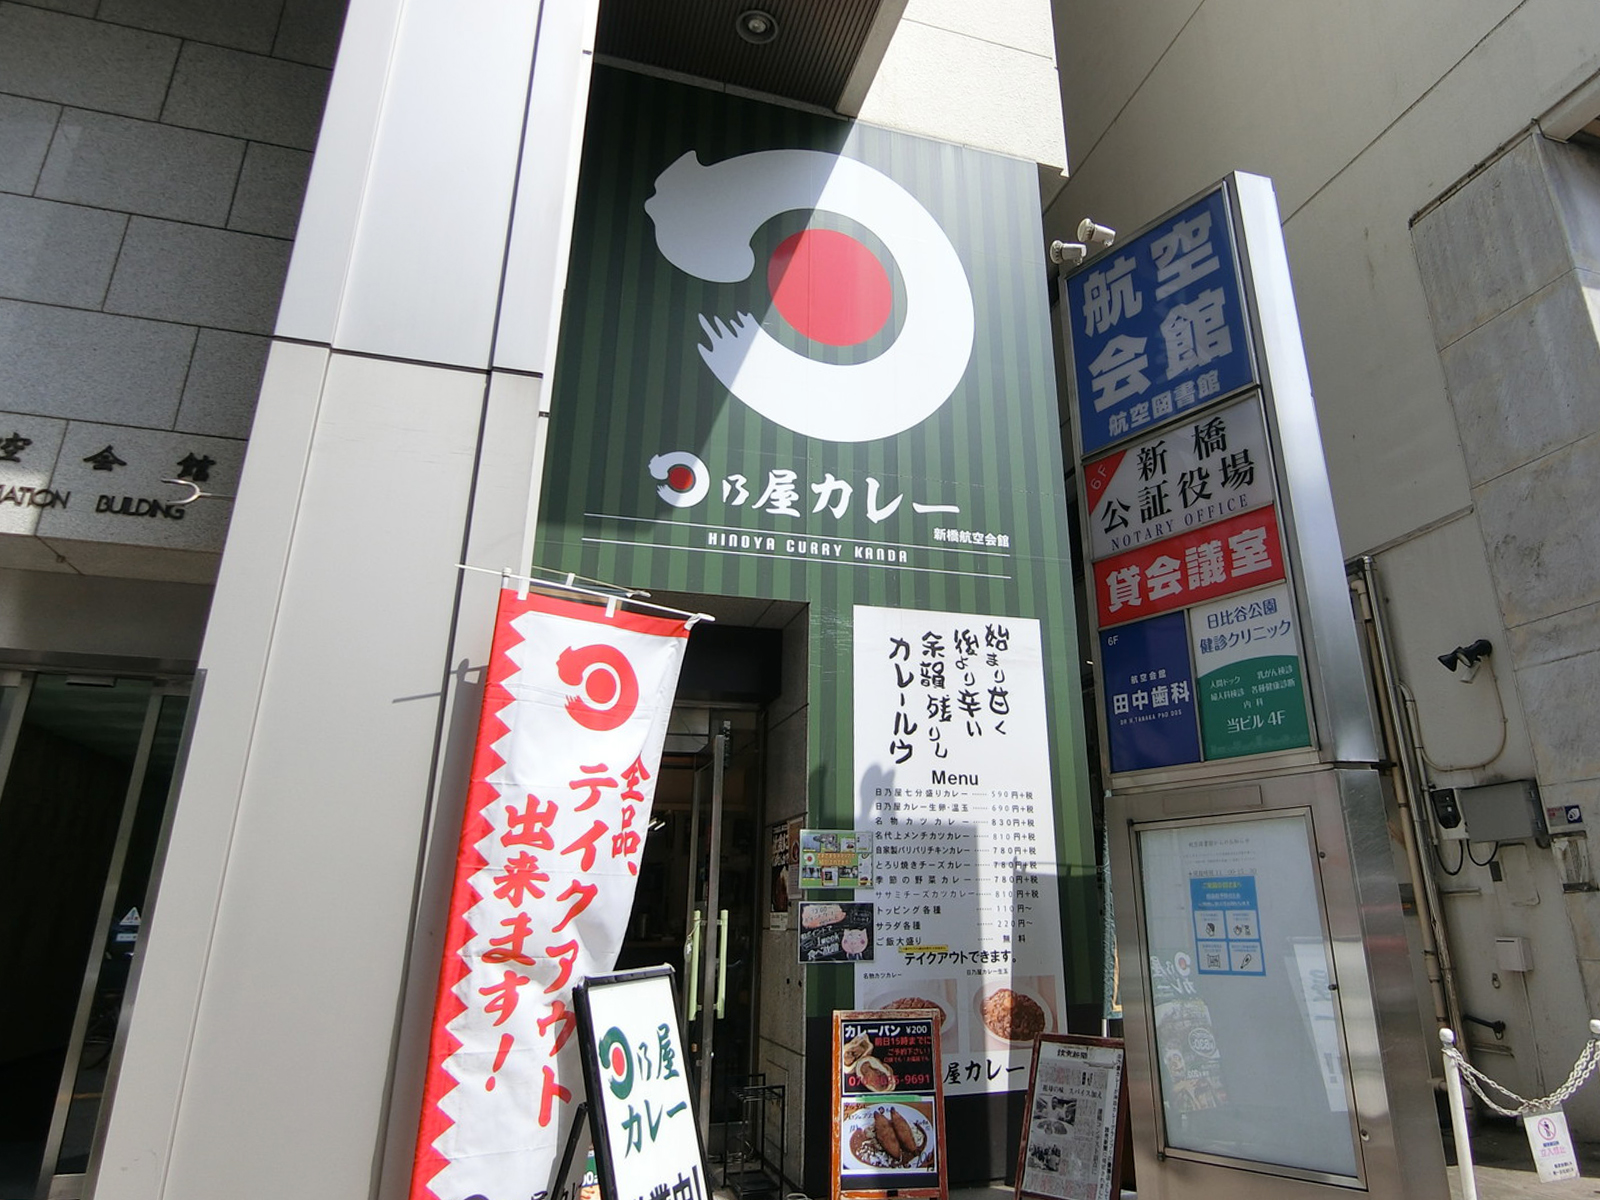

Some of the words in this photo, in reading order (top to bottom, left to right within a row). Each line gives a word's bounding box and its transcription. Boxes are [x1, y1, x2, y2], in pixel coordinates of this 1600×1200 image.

[1136, 416, 1226, 481] 新橋
[1090, 463, 1108, 490] 6F
[96, 494, 186, 520] BUILDING
[1101, 449, 1254, 535] 公証役場
[933, 526, 1010, 548] 新橋航空会館
[1111, 519, 1175, 551] NOTARY
[1184, 493, 1249, 527] OFFICE
[707, 531, 776, 552] HINOYA
[786, 539, 843, 558] CURRY
[854, 545, 909, 564] KANDA
[1105, 526, 1273, 613] 貸会議室
[1207, 597, 1278, 630] 日比谷公園
[1107, 634, 1119, 647] 6F
[1199, 619, 1292, 655] 健診クリニック
[954, 628, 983, 737] 後より辛い
[985, 623, 1011, 736] 始まり甘く
[1209, 675, 1241, 690] 人間ドック
[889, 637, 918, 765] カレールウ
[920, 631, 952, 759] 余韻残りし
[1113, 680, 1190, 716] 田中歯科
[1227, 714, 1265, 734] 当ビル
[1267, 709, 1286, 726] 4F
[932, 770, 979, 786] Menu
[875, 816, 969, 826] 名物カツカレー
[876, 905, 942, 915] トッピング各種
[876, 920, 921, 931] サラダ各種
[537, 762, 619, 1128] テイクアウト
[876, 936, 922, 946] ご飯大盛り
[904, 950, 1017, 966] テイクアウトできます。
[845, 1025, 901, 1038] カレーパン
[905, 1025, 928, 1034] ¥200
[943, 1058, 1025, 1085] 屋カレー
[621, 1099, 688, 1159] カレー
